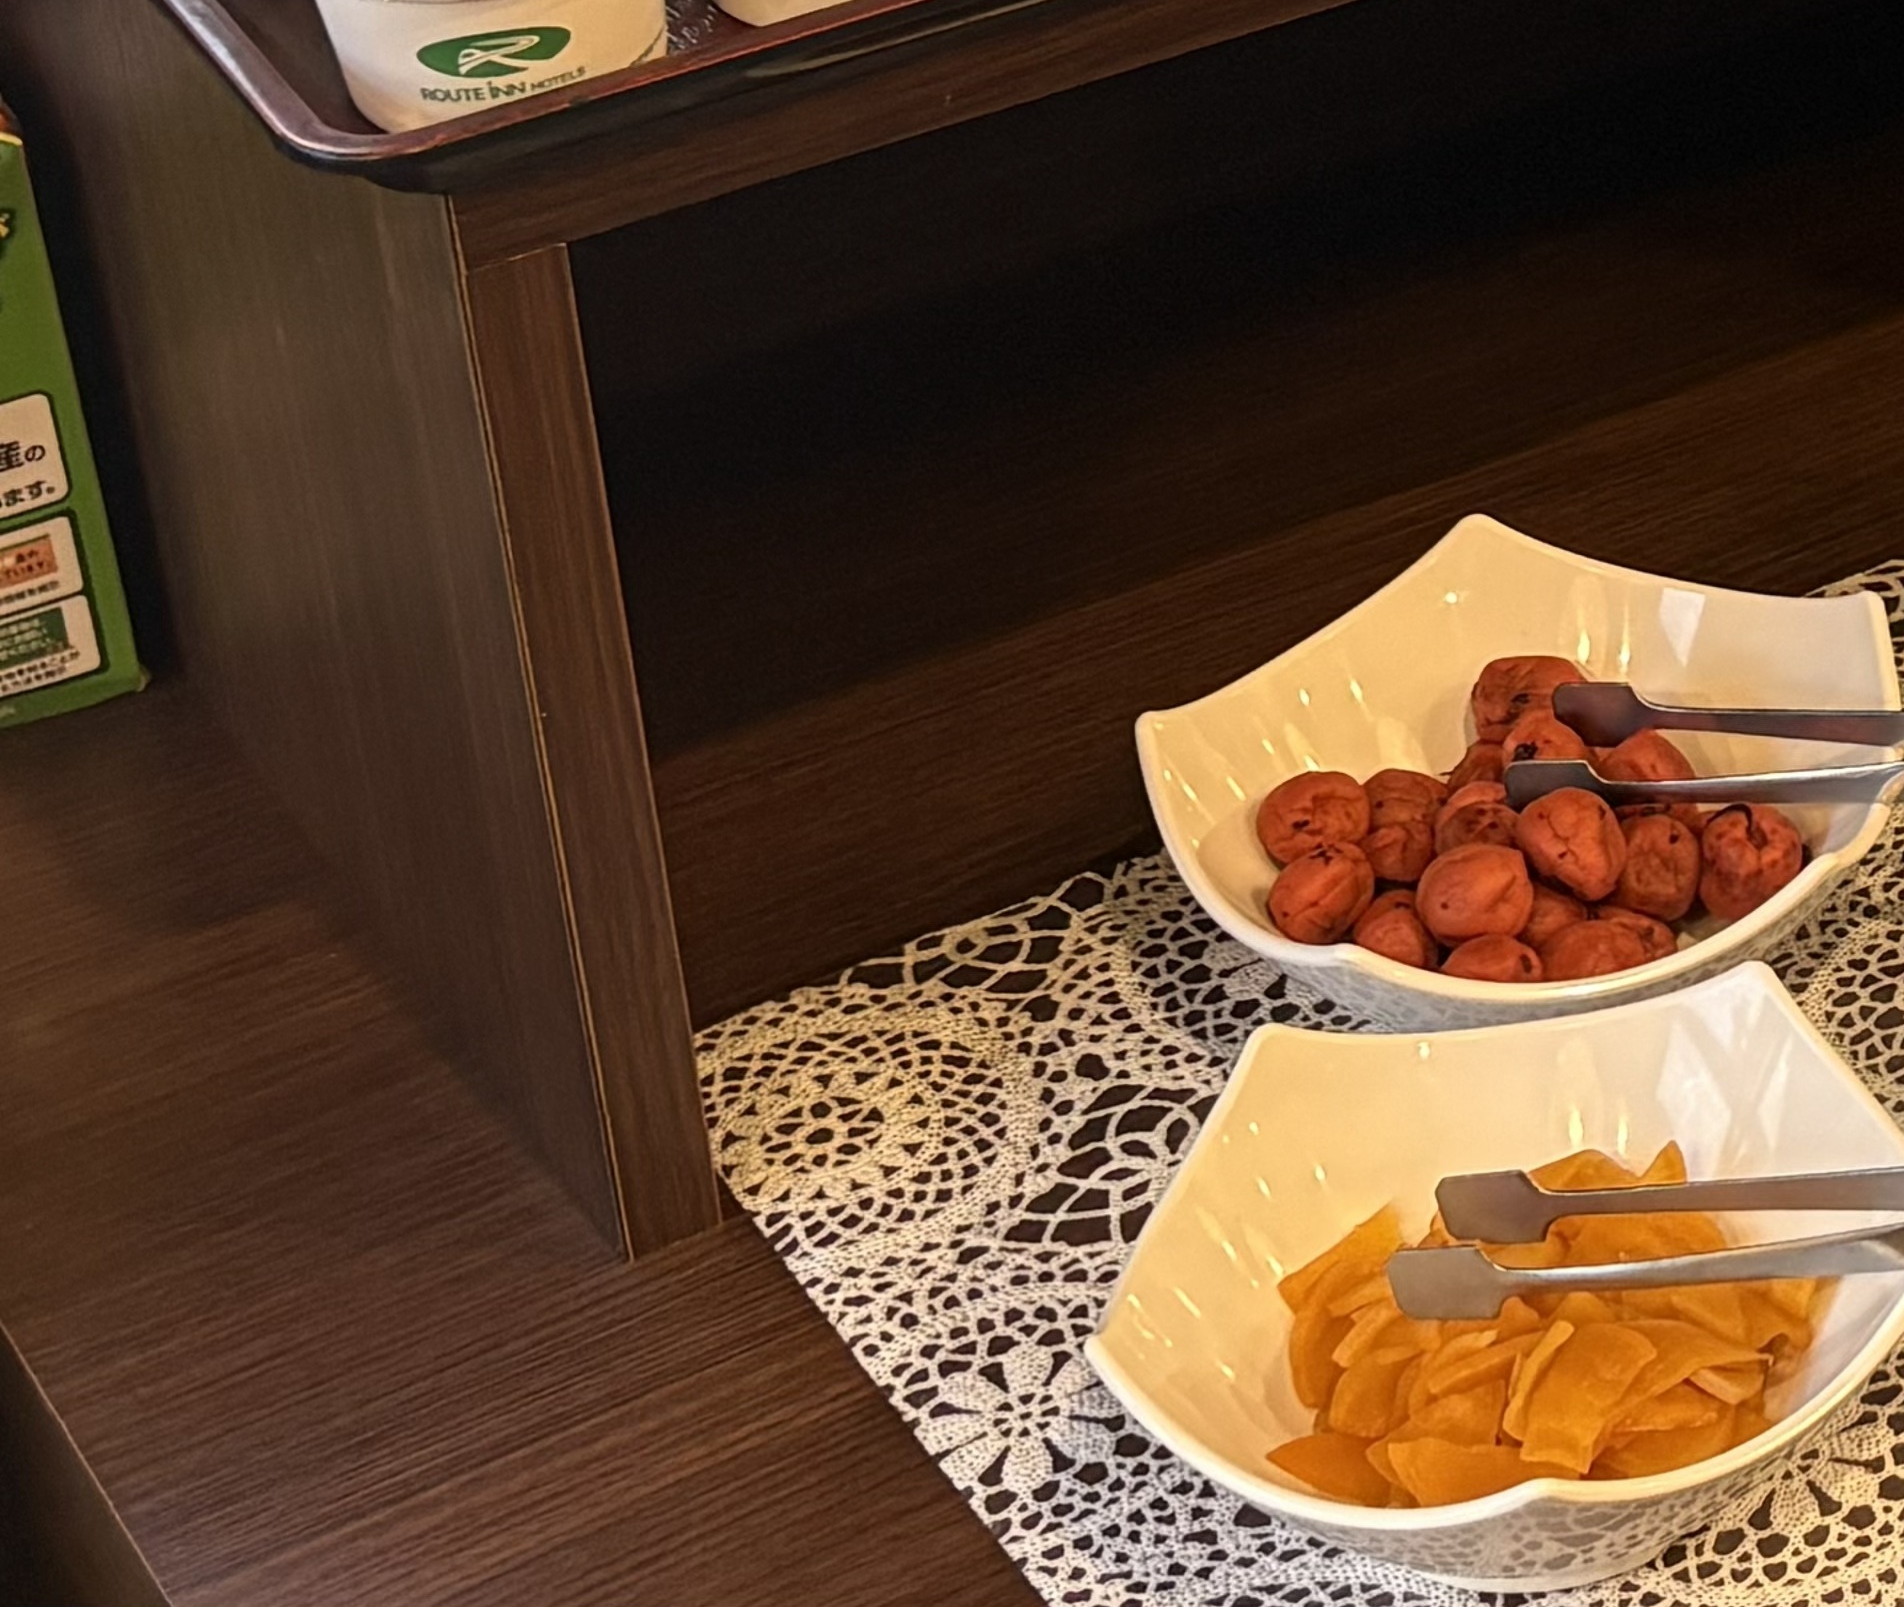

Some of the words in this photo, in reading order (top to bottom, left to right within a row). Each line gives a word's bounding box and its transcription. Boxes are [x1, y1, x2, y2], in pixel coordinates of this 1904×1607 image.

[420, 87, 486, 102] ROUTE
[487, 80, 526, 99] INN
[530, 66, 586, 90] HOTELS
[0, 480, 55, 508] ます。
